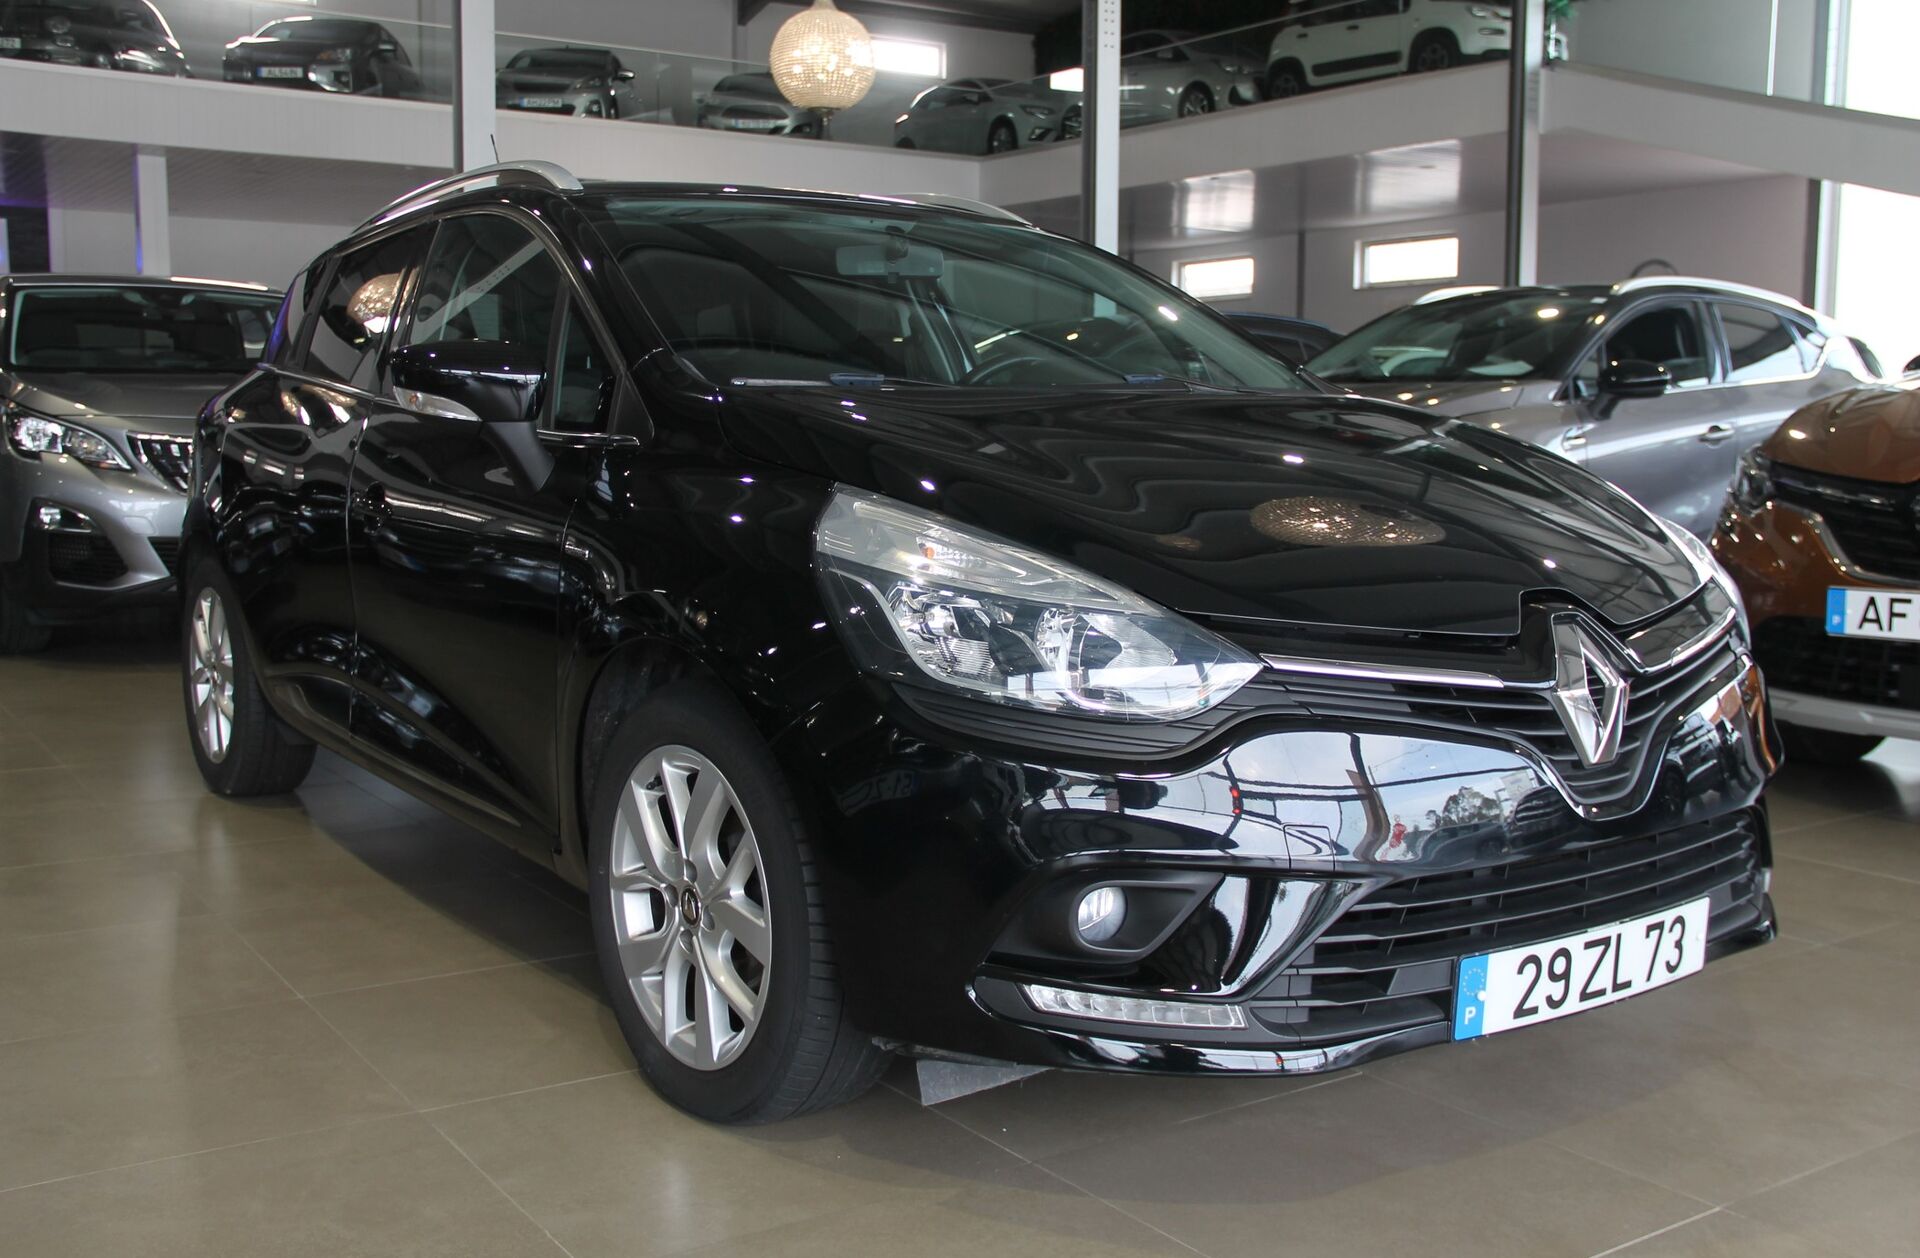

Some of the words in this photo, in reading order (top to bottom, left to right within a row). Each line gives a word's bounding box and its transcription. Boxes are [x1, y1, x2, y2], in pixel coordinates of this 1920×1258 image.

[1858, 595, 1912, 632] AF
[1464, 1006, 1477, 1025] P
[1645, 914, 1686, 983] 73
